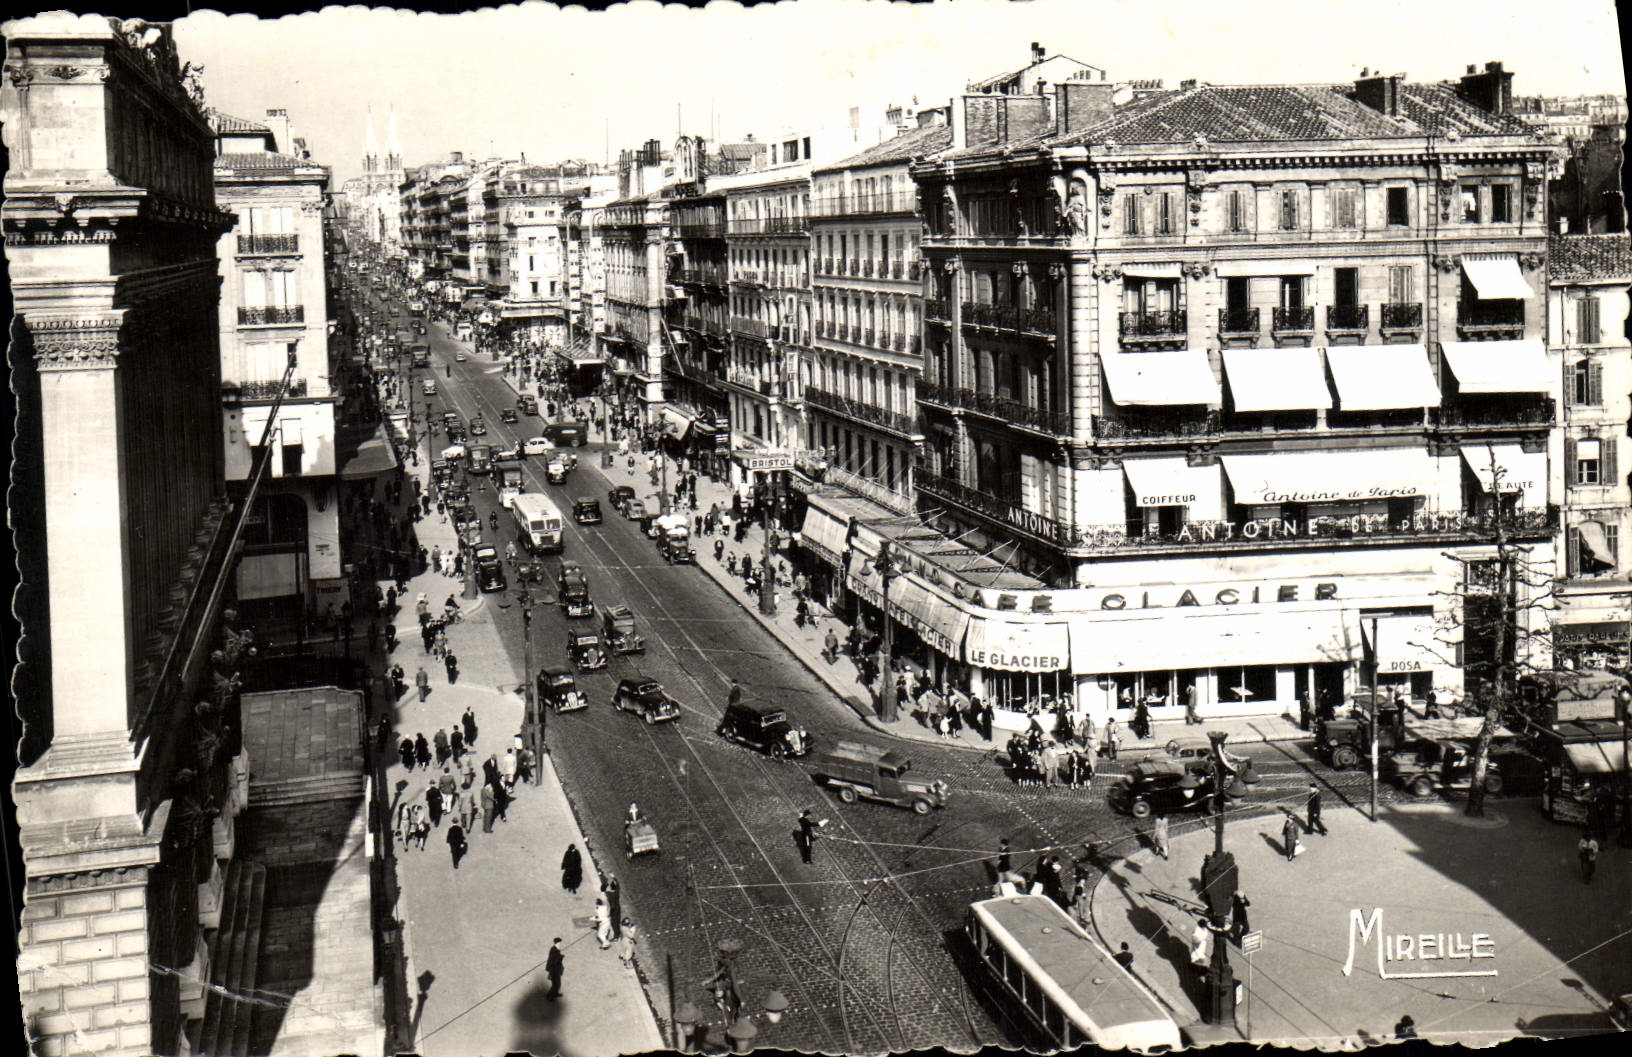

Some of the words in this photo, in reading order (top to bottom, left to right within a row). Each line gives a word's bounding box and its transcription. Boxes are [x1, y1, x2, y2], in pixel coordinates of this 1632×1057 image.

[751, 458, 792, 467] BRISTOL
[1490, 481, 1535, 490] EAUTE
[1142, 493, 1197, 505] COIFFEUR
[1263, 490, 1340, 502] Antoine
[1348, 489, 1363, 498] de
[1007, 506, 1058, 541] ANTOINE
[1177, 518, 1320, 542] ANTOINE
[1401, 517, 1462, 533] PARIS
[1100, 582, 1338, 611] GLACIER
[971, 650, 986, 663] LE
[990, 653, 1060, 668] GLACIER
[1391, 661, 1421, 671] ROSA
